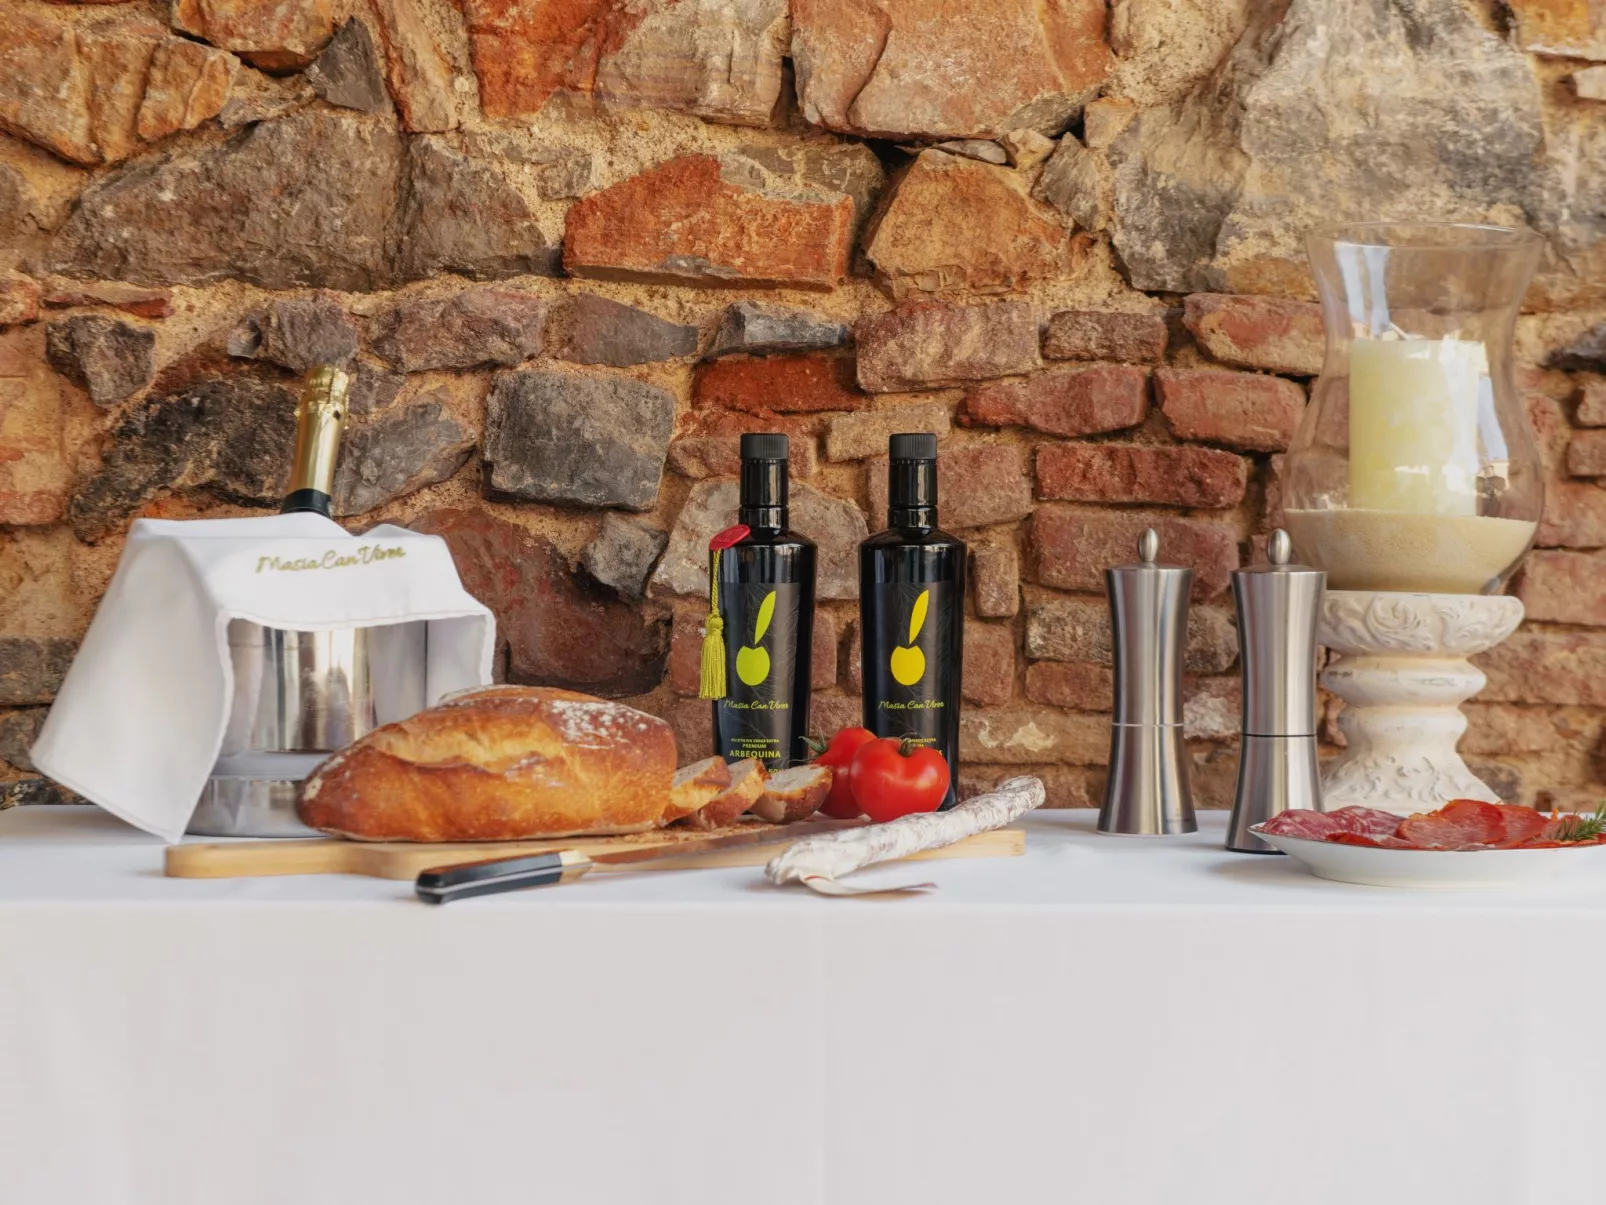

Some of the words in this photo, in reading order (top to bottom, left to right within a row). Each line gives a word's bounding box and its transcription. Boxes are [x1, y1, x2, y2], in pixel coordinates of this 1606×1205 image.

[321, 549, 358, 570] Can
[723, 699, 749, 709] Masia
[750, 700, 769, 710] Can
[877, 700, 906, 710] Masia
[907, 700, 924, 710] Can
[729, 749, 781, 760] ARBEQUINA
